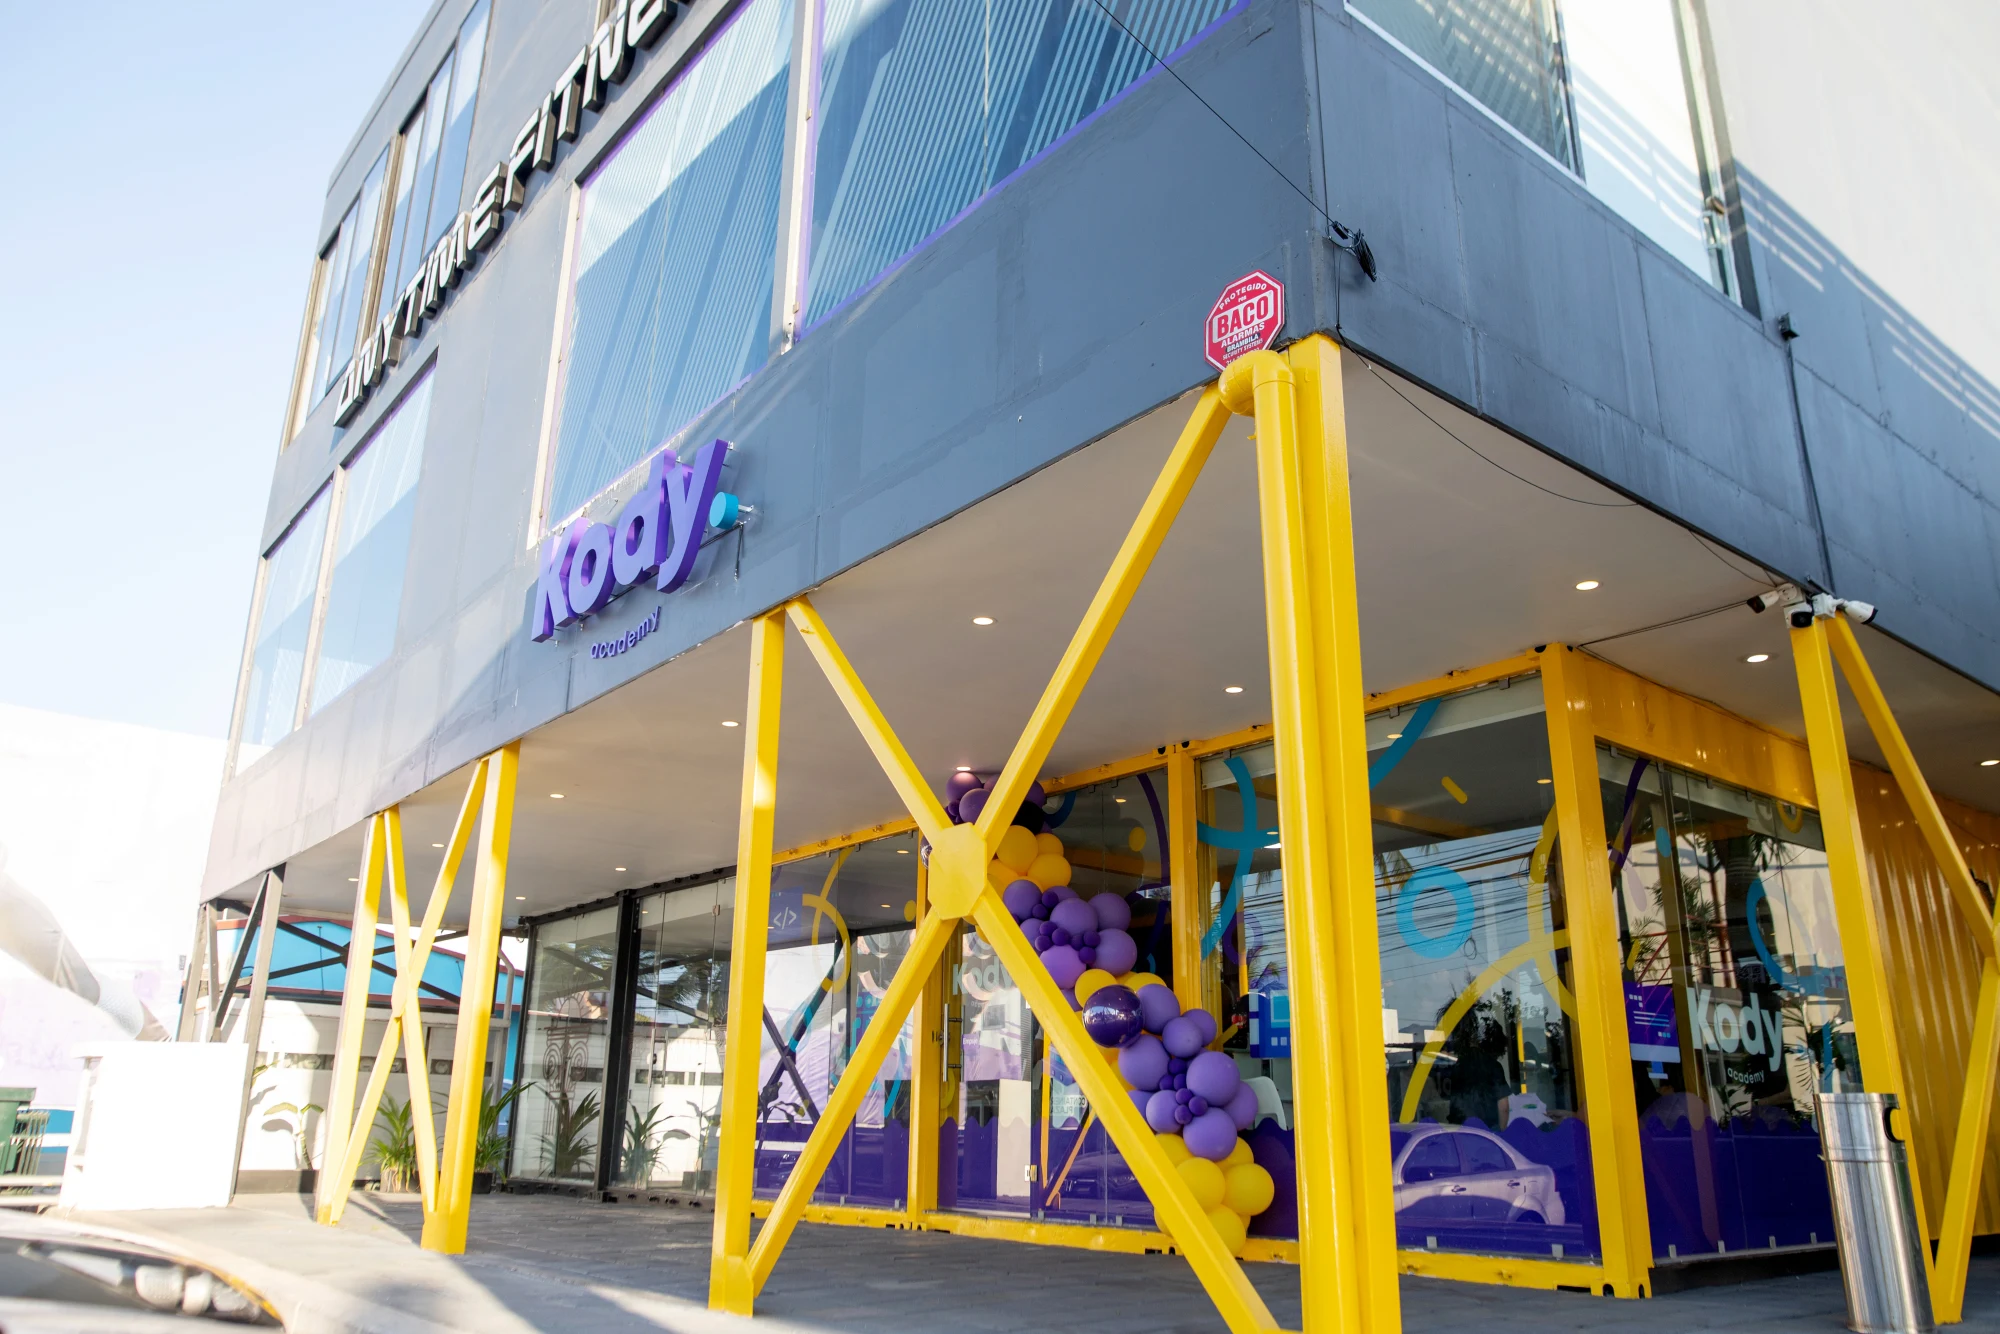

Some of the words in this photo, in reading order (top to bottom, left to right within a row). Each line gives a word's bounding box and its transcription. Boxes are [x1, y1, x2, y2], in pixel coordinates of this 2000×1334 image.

[1219, 283, 1267, 310] PROTEGIDO
[1217, 296, 1269, 339] BACO
[1221, 322, 1265, 348] ALARMAS
[590, 606, 661, 659] academy
[1687, 987, 1782, 1072] Kody
[1727, 1066, 1765, 1084] academy
